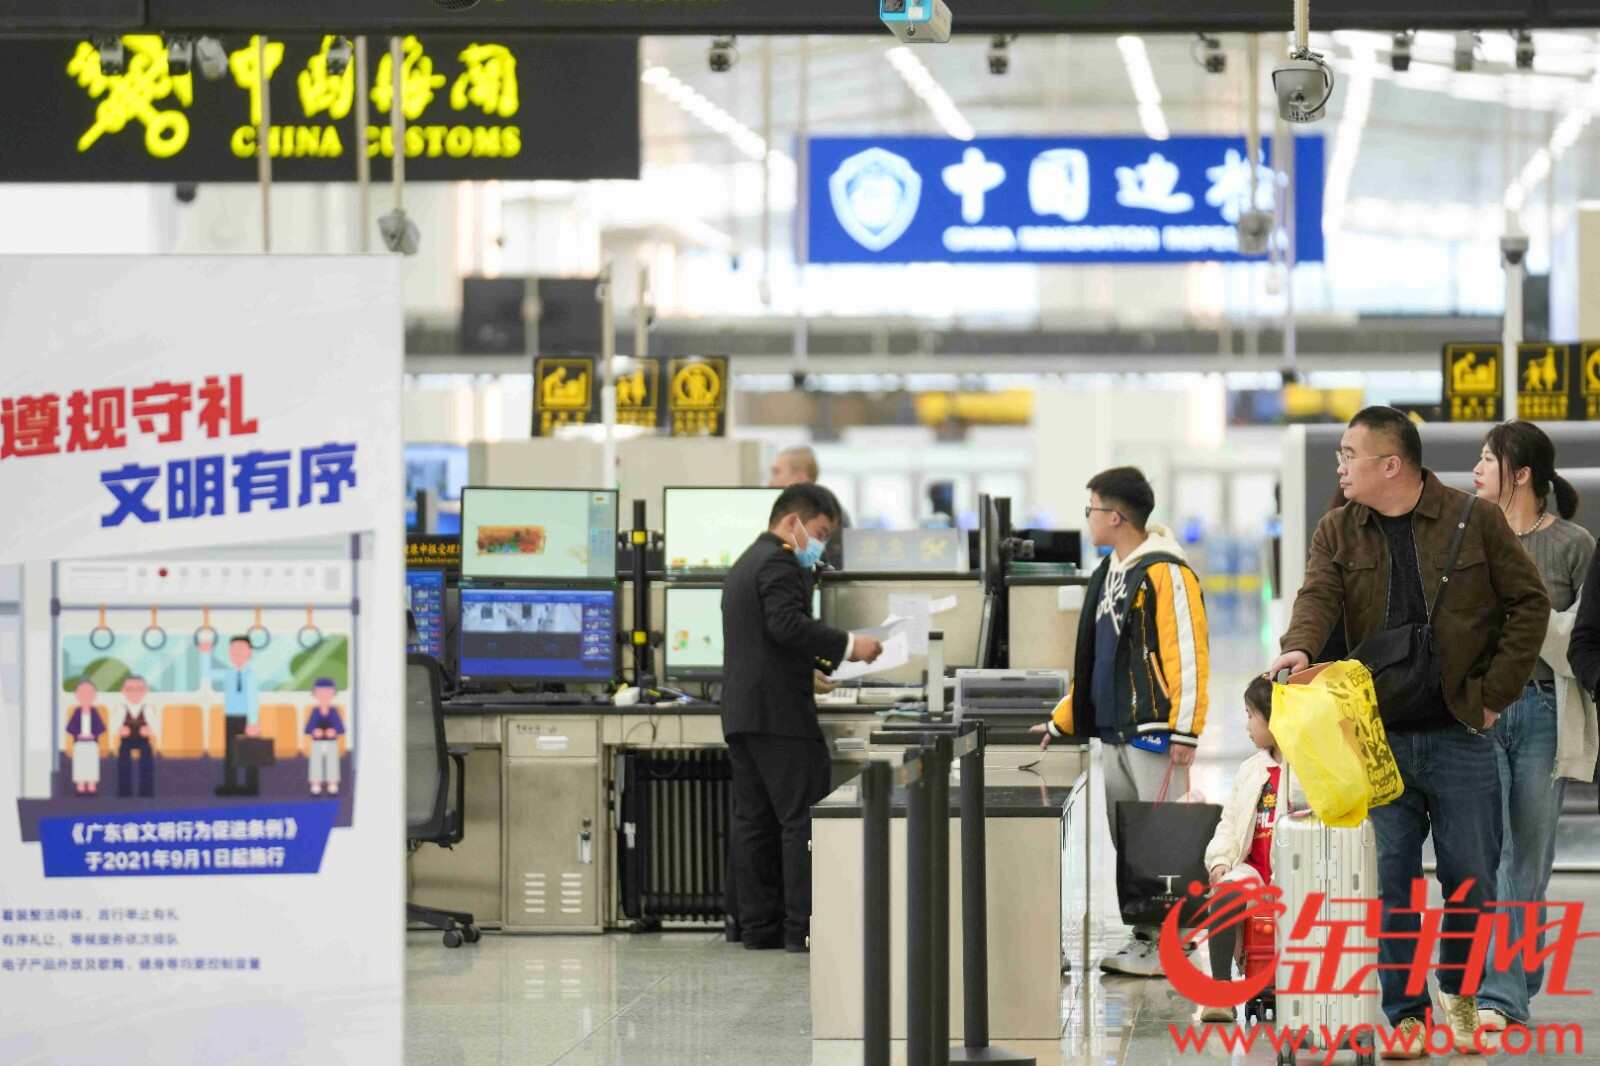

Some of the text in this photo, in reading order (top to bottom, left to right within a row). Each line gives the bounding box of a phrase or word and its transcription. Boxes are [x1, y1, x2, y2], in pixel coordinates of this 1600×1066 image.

[228, 34, 519, 124] 中国海关
[230, 126, 343, 158] CHINA
[0, 373, 258, 460] 遵规守礼
[100, 443, 357, 528] 文明有序
[72, 817, 298, 845] 《广东省文明行为促进条例》
[85, 846, 285, 872] 于2021年9月1日起施行
